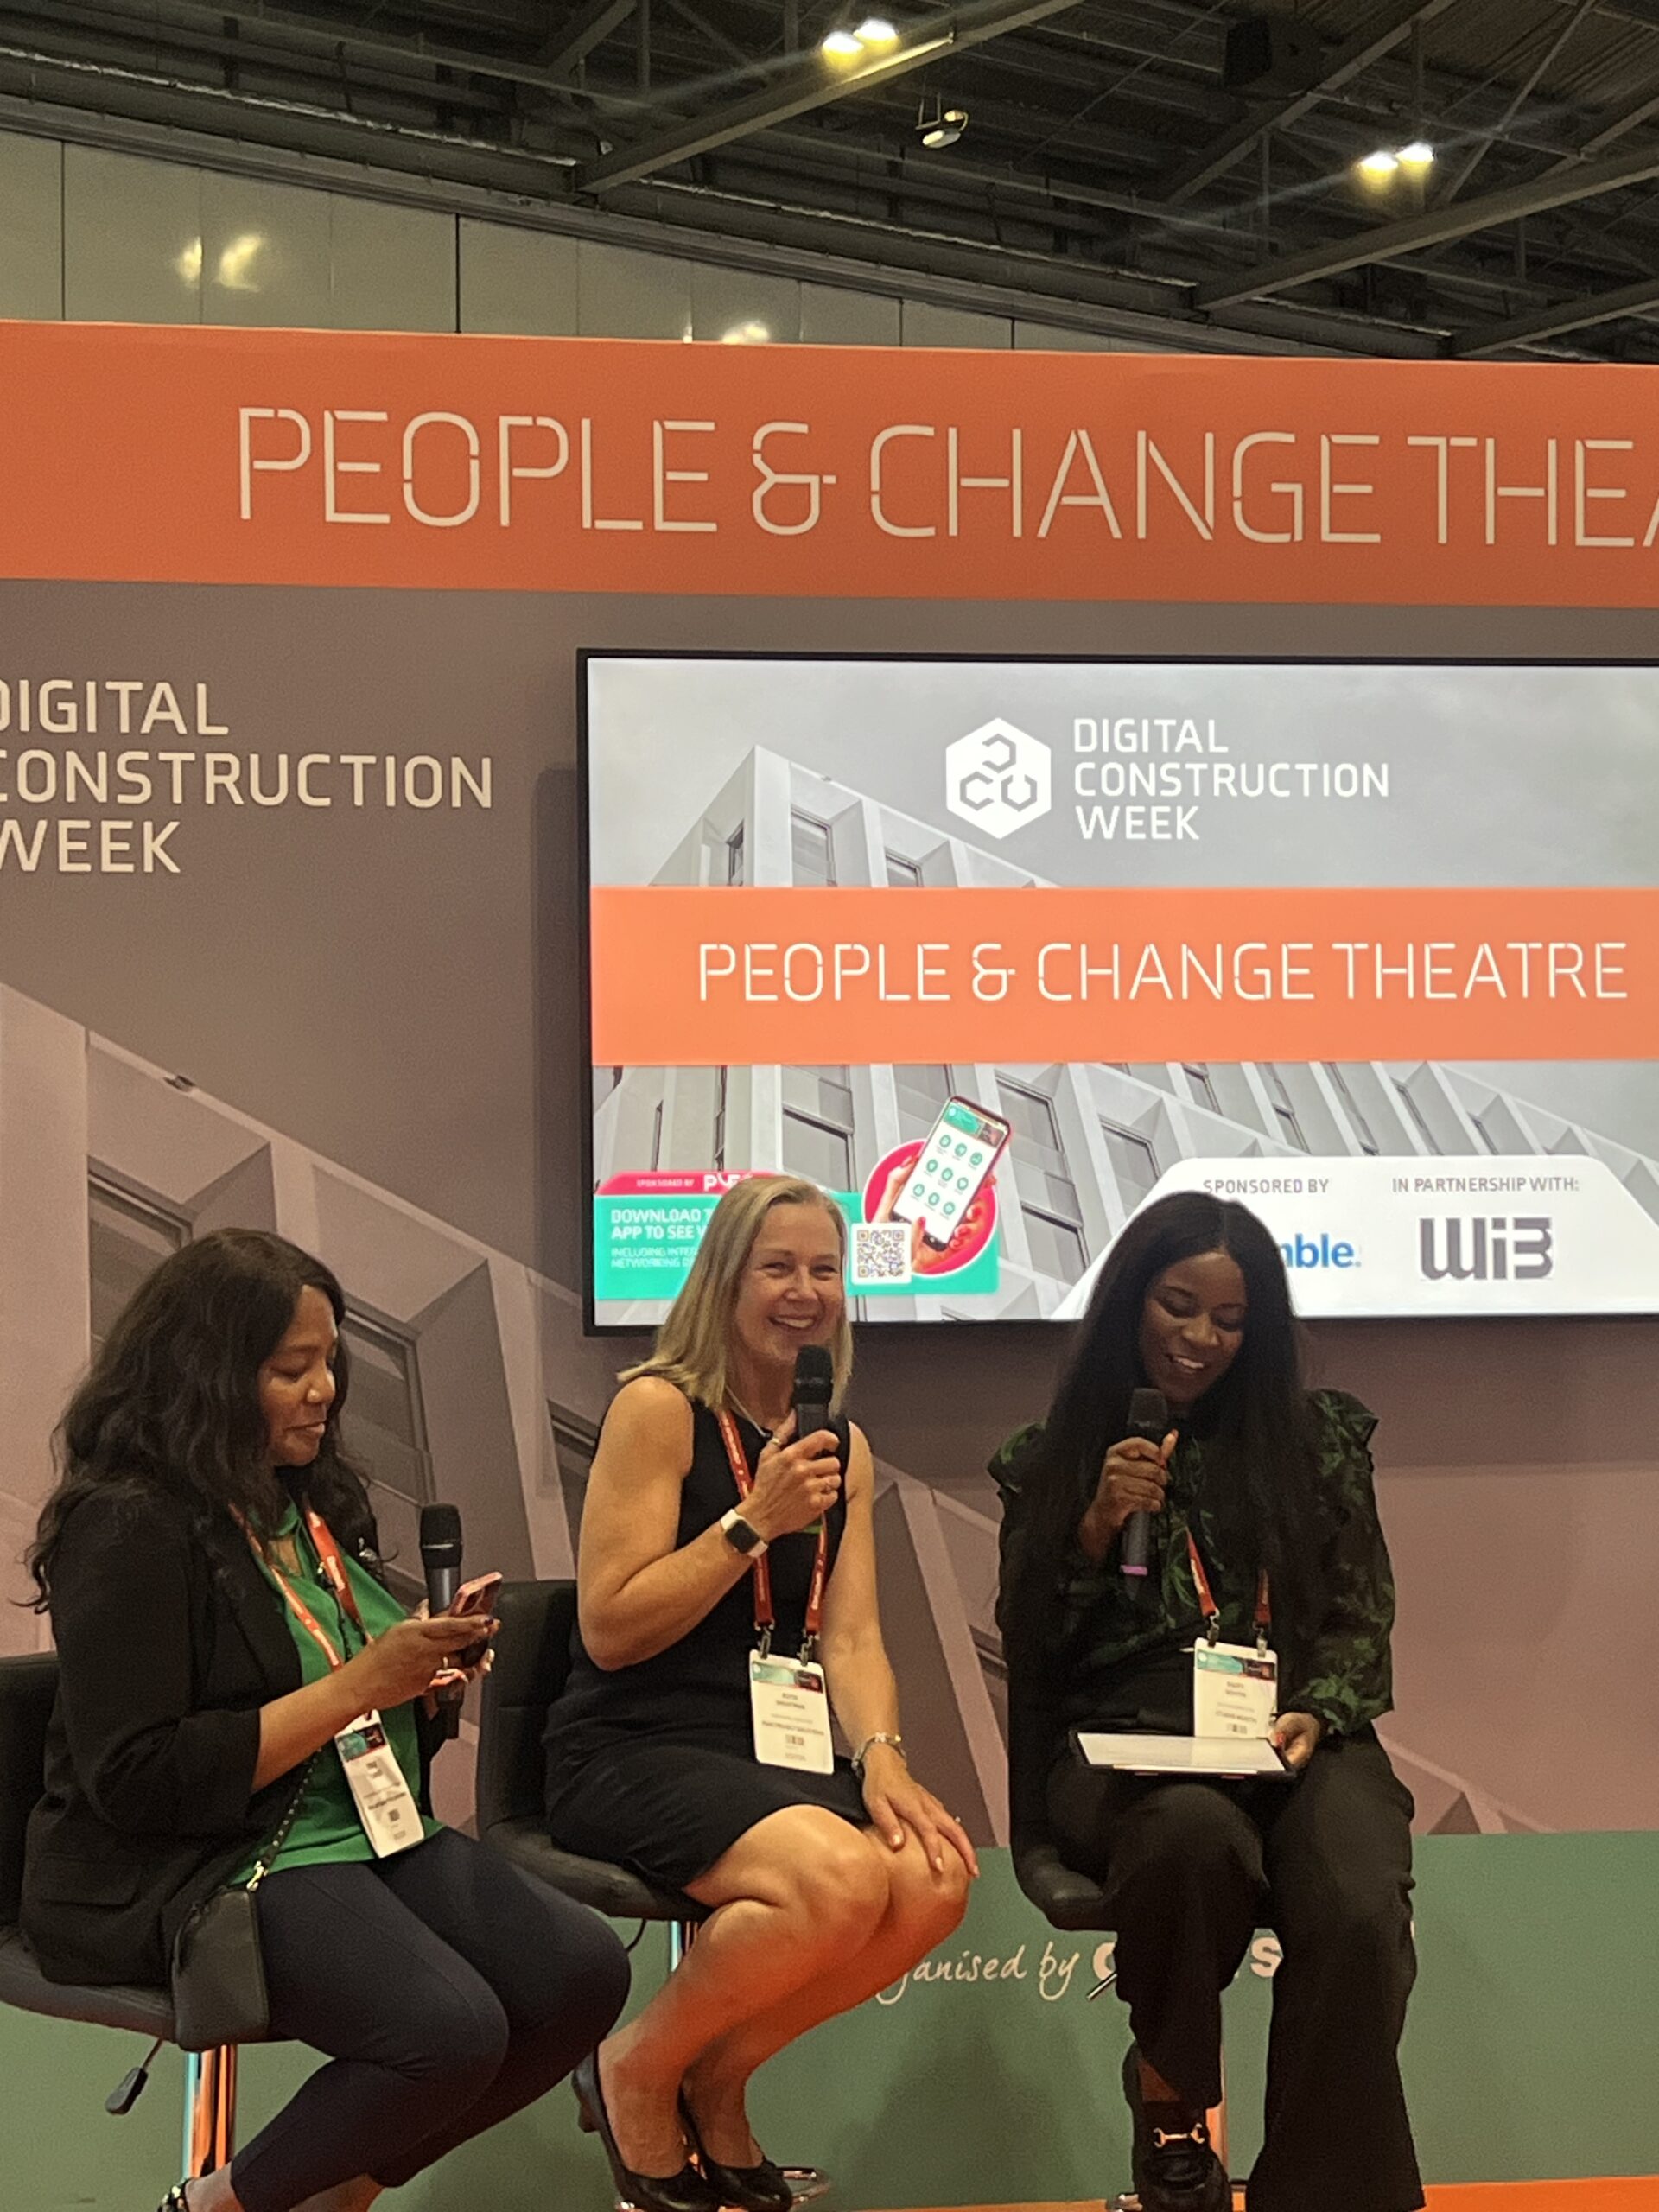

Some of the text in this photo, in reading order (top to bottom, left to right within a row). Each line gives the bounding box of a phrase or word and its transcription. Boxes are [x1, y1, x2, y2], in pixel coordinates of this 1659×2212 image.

[239, 407, 1659, 548] PEOPLE & CHANGE THE
[0, 679, 230, 735] IGITAL
[1074, 718, 1229, 753] DIGITAL
[0, 749, 493, 809] ONSTRUCTION
[1074, 762, 1389, 798] CONSTRUCTION
[1075, 805, 1200, 840] WEEK
[699, 942, 1628, 1001] PEOPLE & CHANGE THEATRE
[1203, 1179, 1329, 1194] SPONSORED BY
[1392, 1176, 1580, 1192] IN PARTNERSHIP WITH:
[611, 1209, 702, 1224] DOWNLOAD
[611, 1226, 643, 1240] APP
[645, 1225, 664, 1240] TO
[667, 1225, 695, 1240] SEE
[1039, 1941, 1080, 2000] by
